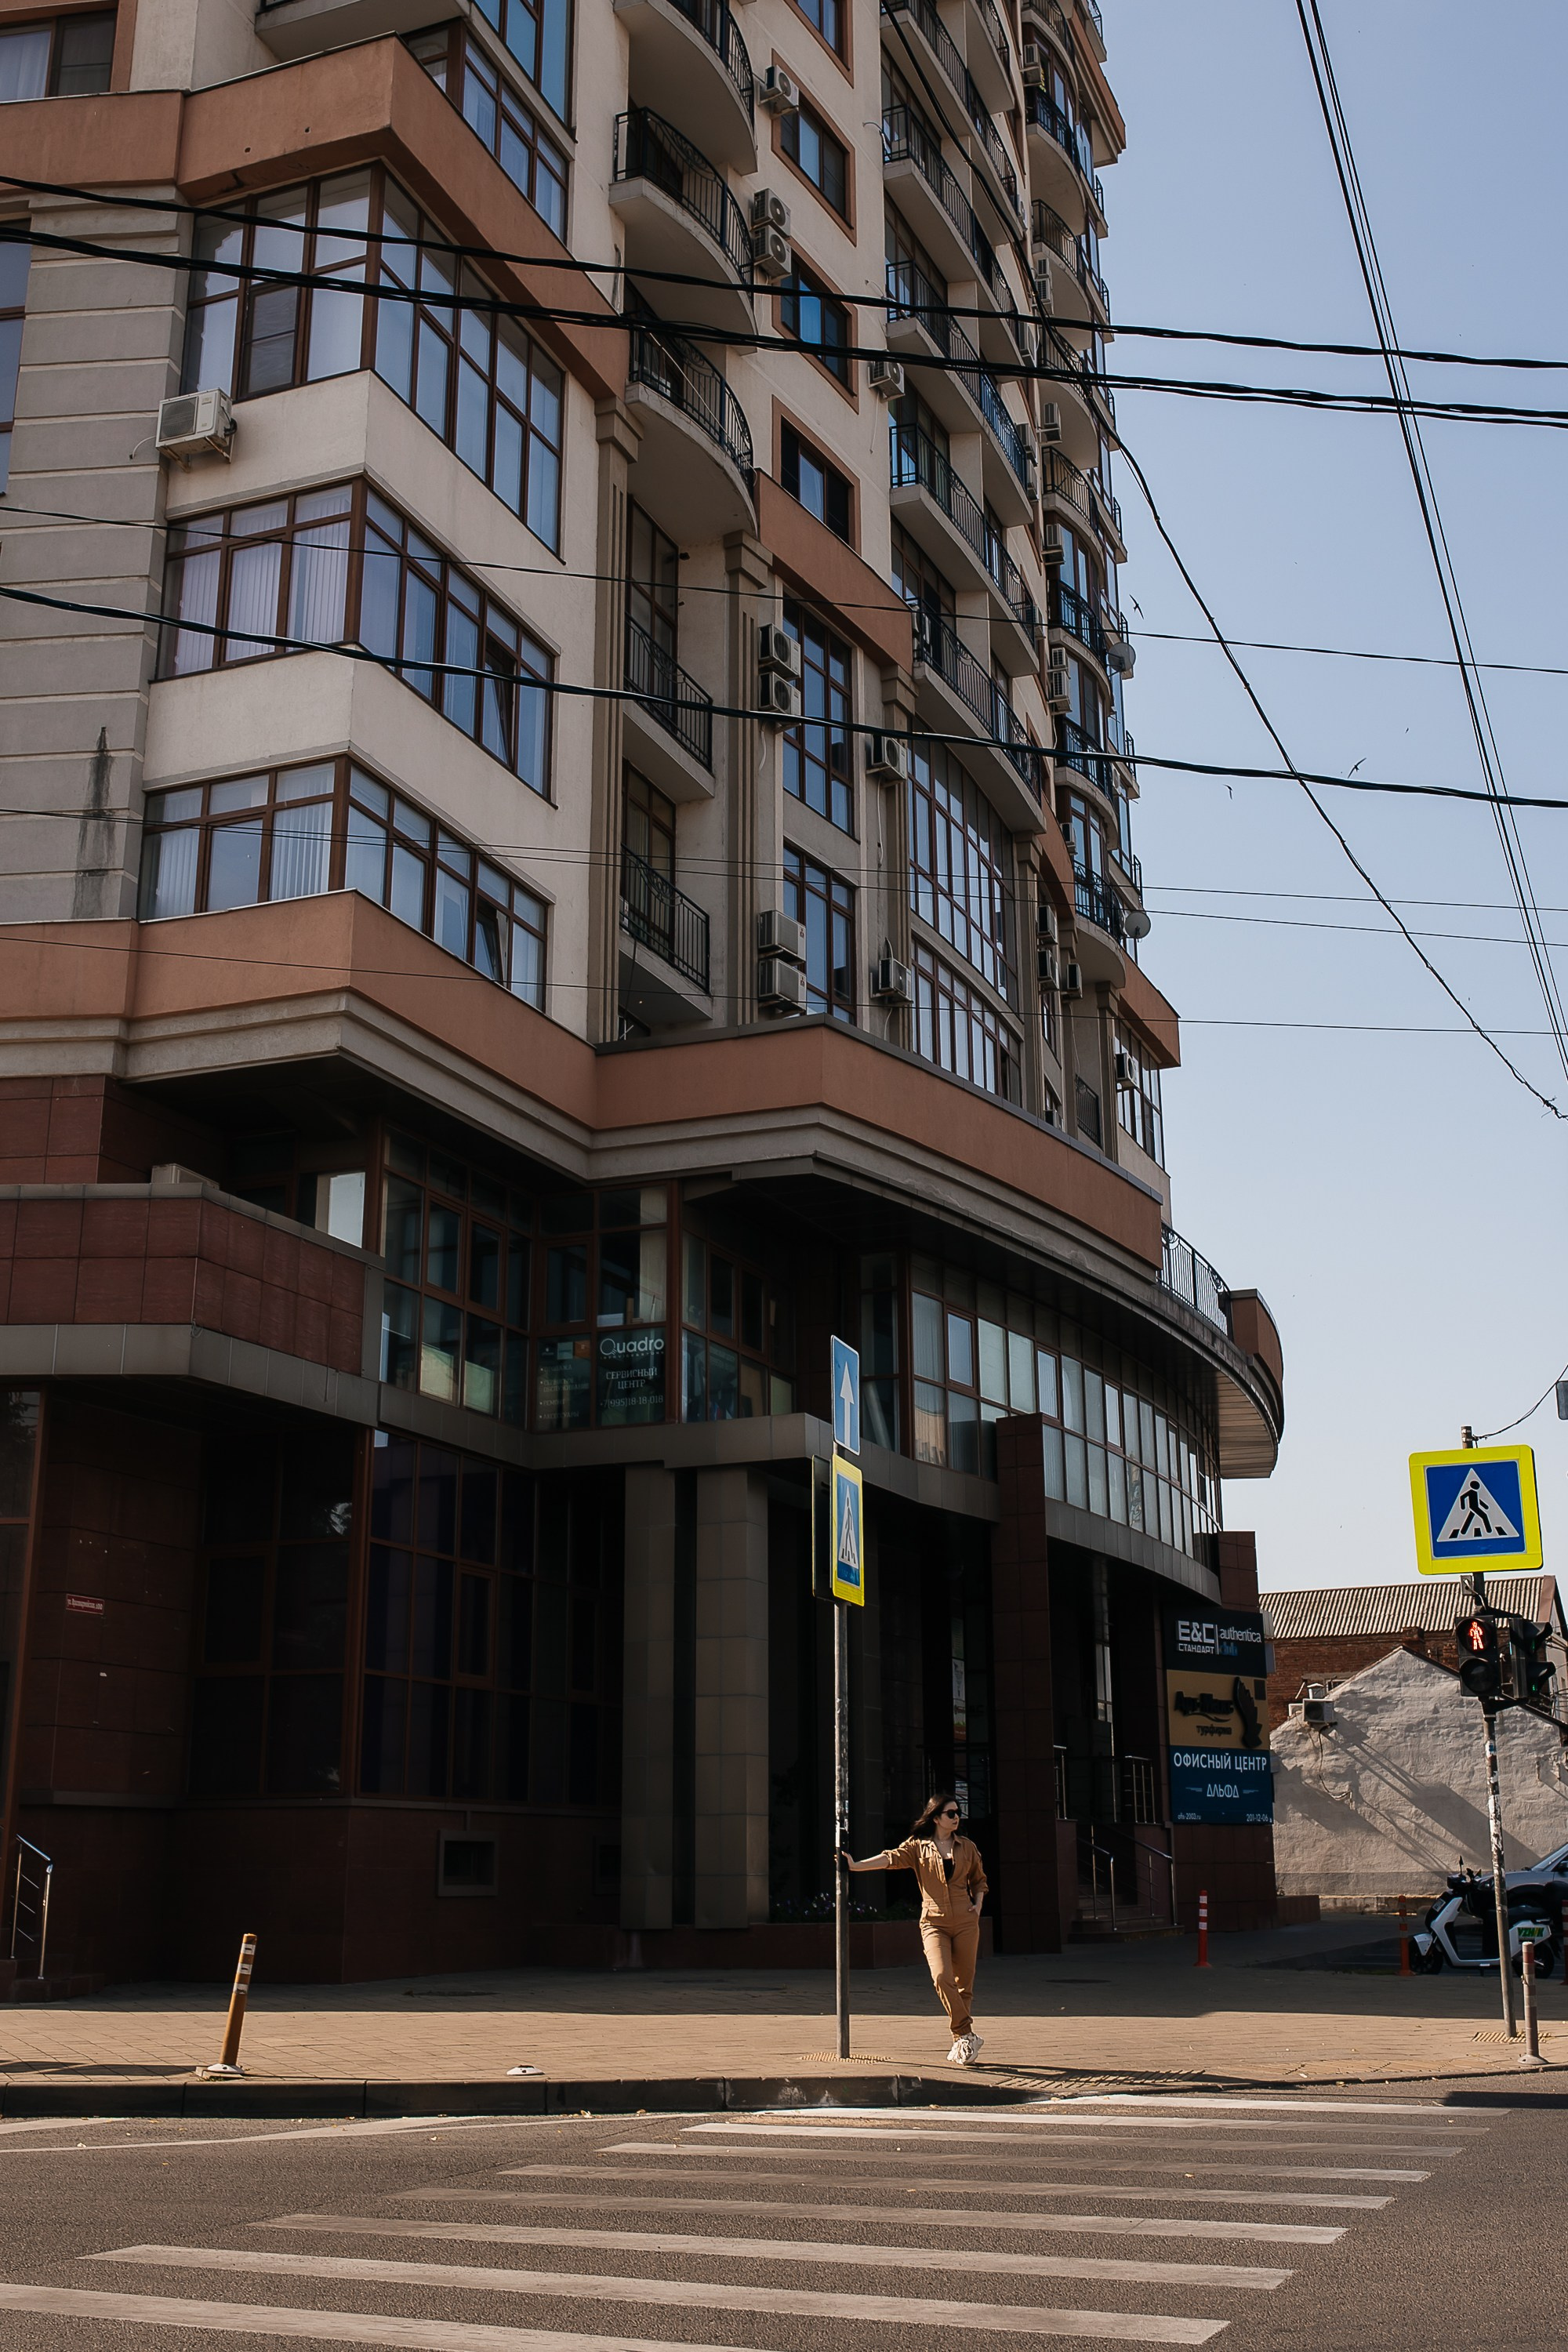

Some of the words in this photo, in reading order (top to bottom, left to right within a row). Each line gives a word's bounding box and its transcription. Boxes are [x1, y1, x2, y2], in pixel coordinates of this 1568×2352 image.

[600, 1336, 665, 1356] Quadro
[605, 1366, 658, 1381] СЕРВИСНЫЙ
[617, 1378, 646, 1390] ЦЕНТР
[1219, 1626, 1261, 1643] authentica
[1178, 1642, 1215, 1654] СТАНДАРТ
[1196, 1724, 1232, 1737] турфирма
[1174, 1751, 1232, 1770] ОФИСНЫЙ
[1235, 1755, 1267, 1773] ЦЕНТР
[1247, 1813, 1269, 1822] 201-12-06
